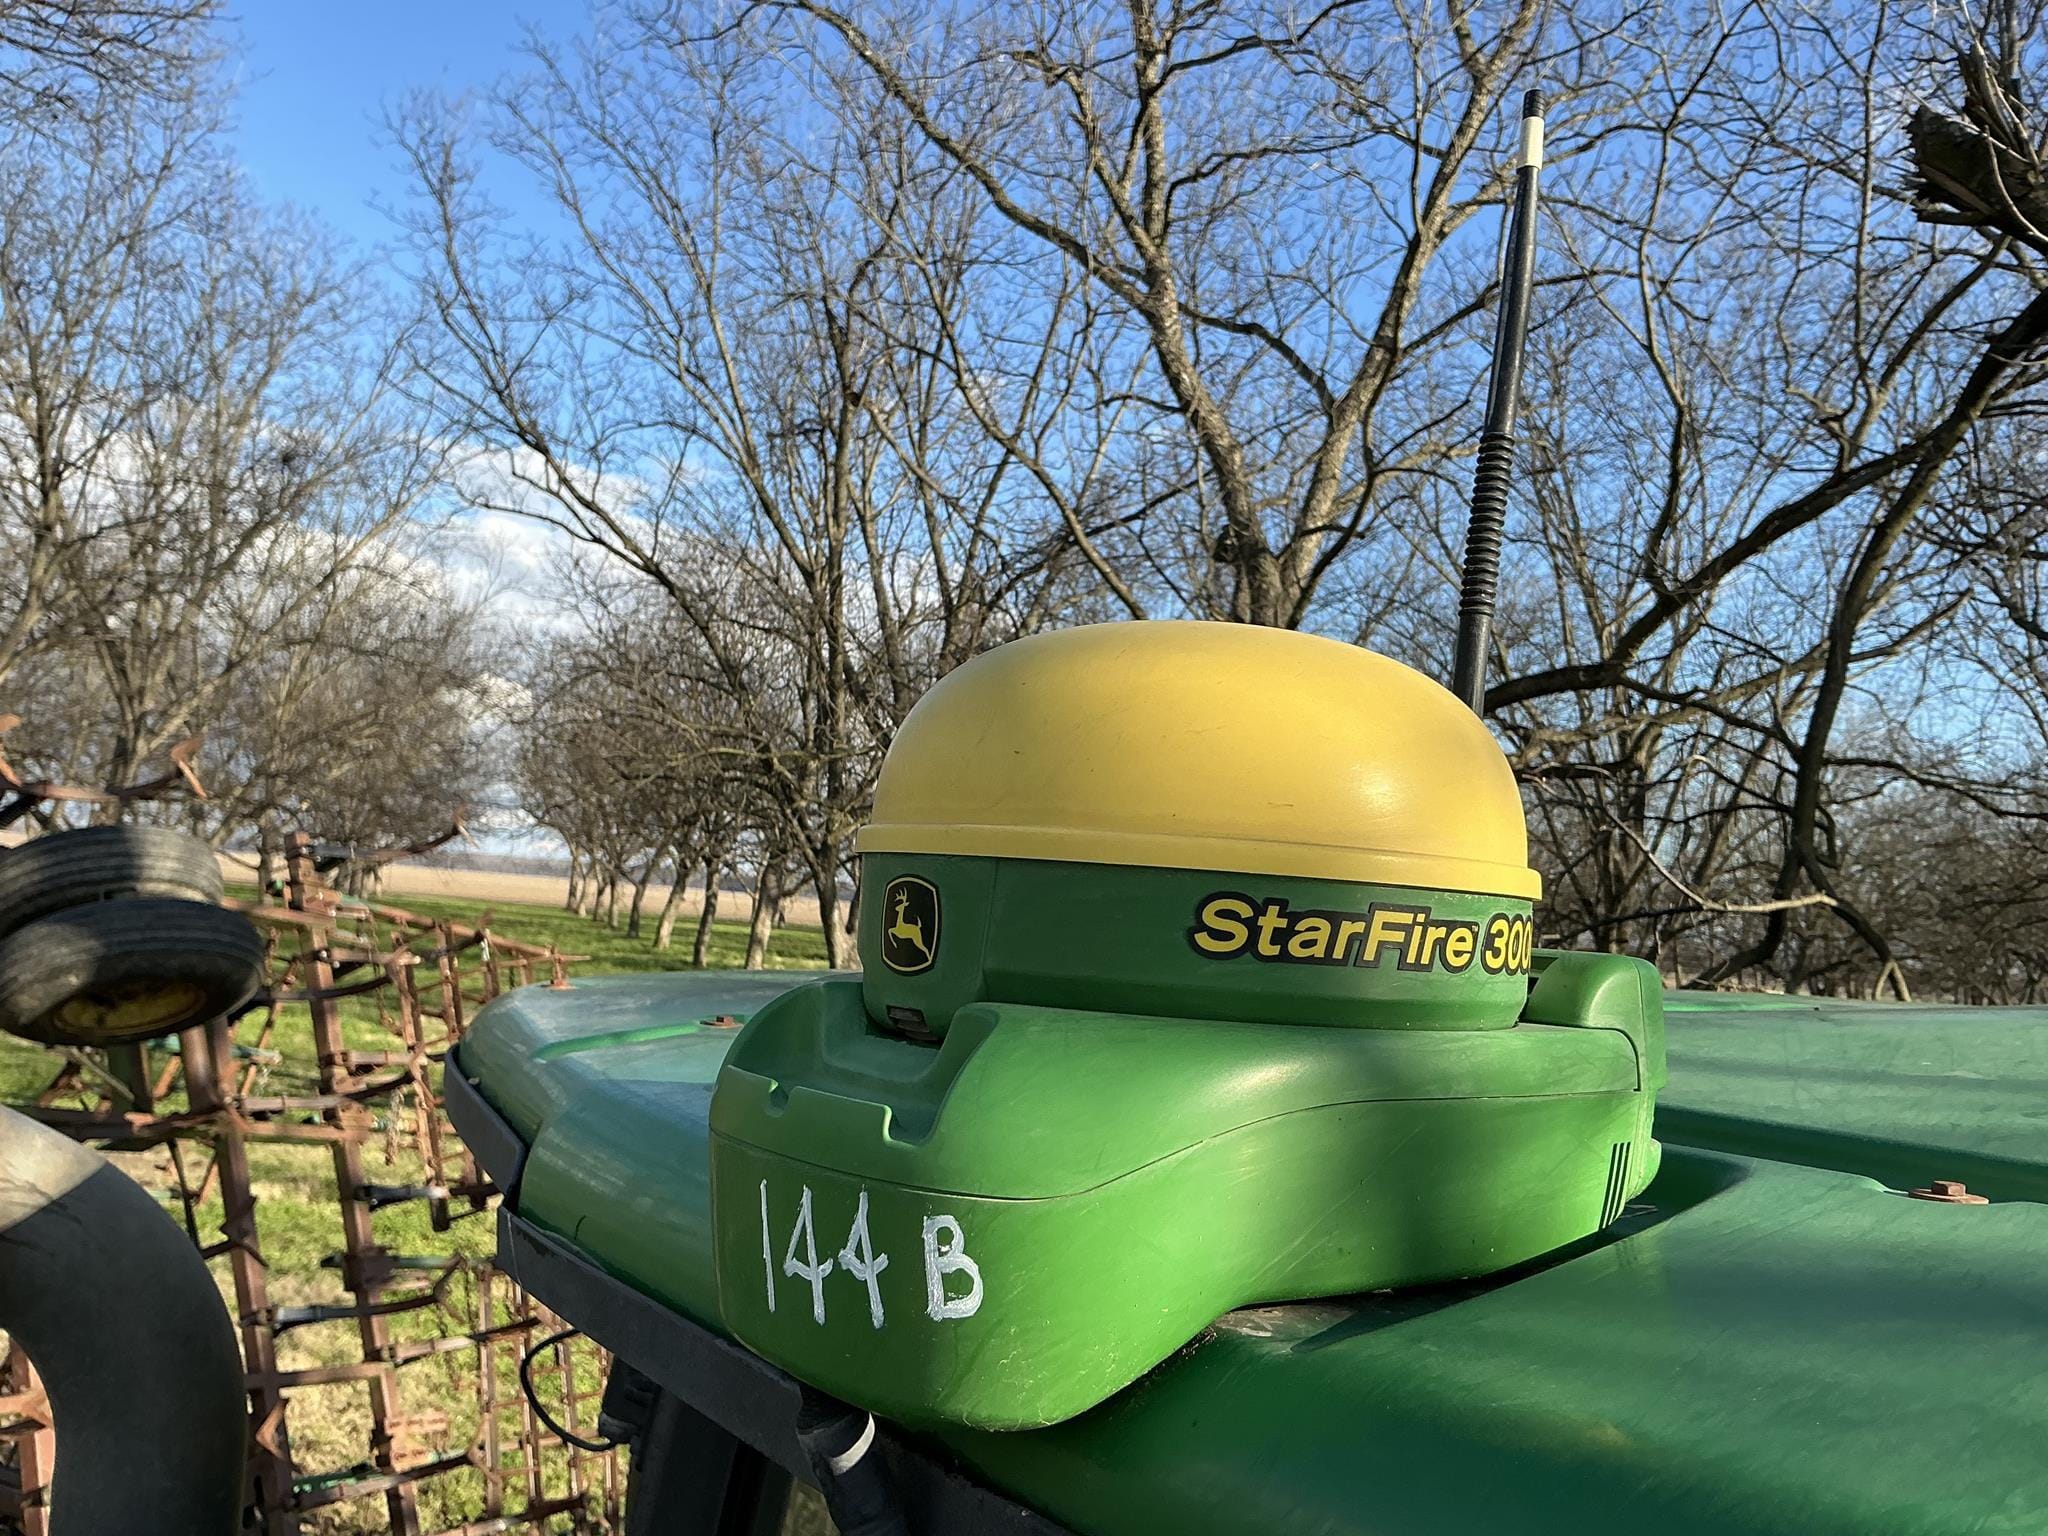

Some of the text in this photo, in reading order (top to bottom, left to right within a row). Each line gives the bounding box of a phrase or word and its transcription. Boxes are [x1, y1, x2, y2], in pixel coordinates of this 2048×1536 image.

[1194, 898, 1474, 968] StarFire
[760, 1178, 984, 1329] 144 B
